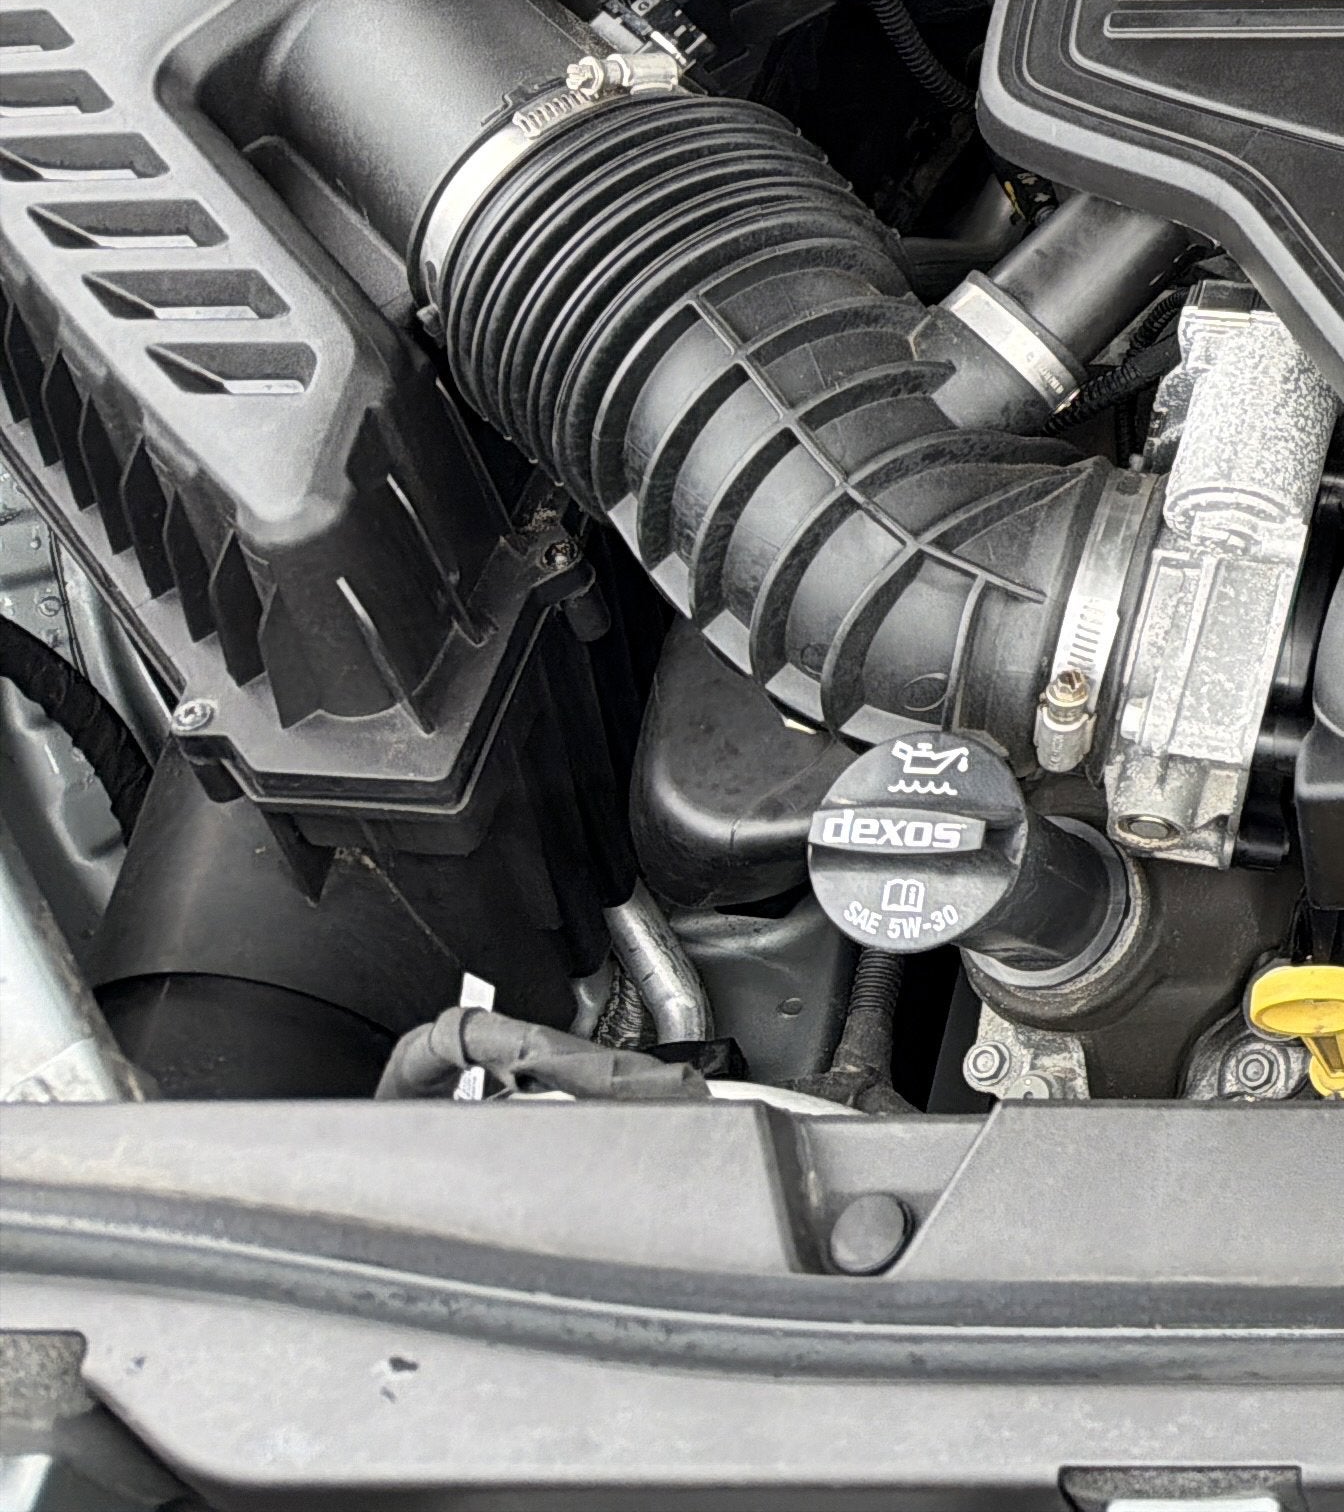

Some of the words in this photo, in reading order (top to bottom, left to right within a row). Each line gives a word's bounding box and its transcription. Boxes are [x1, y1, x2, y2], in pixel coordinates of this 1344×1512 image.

[822, 809, 963, 850] dexos
[843, 900, 883, 935] SAE
[886, 904, 960, 939] 5W-30
